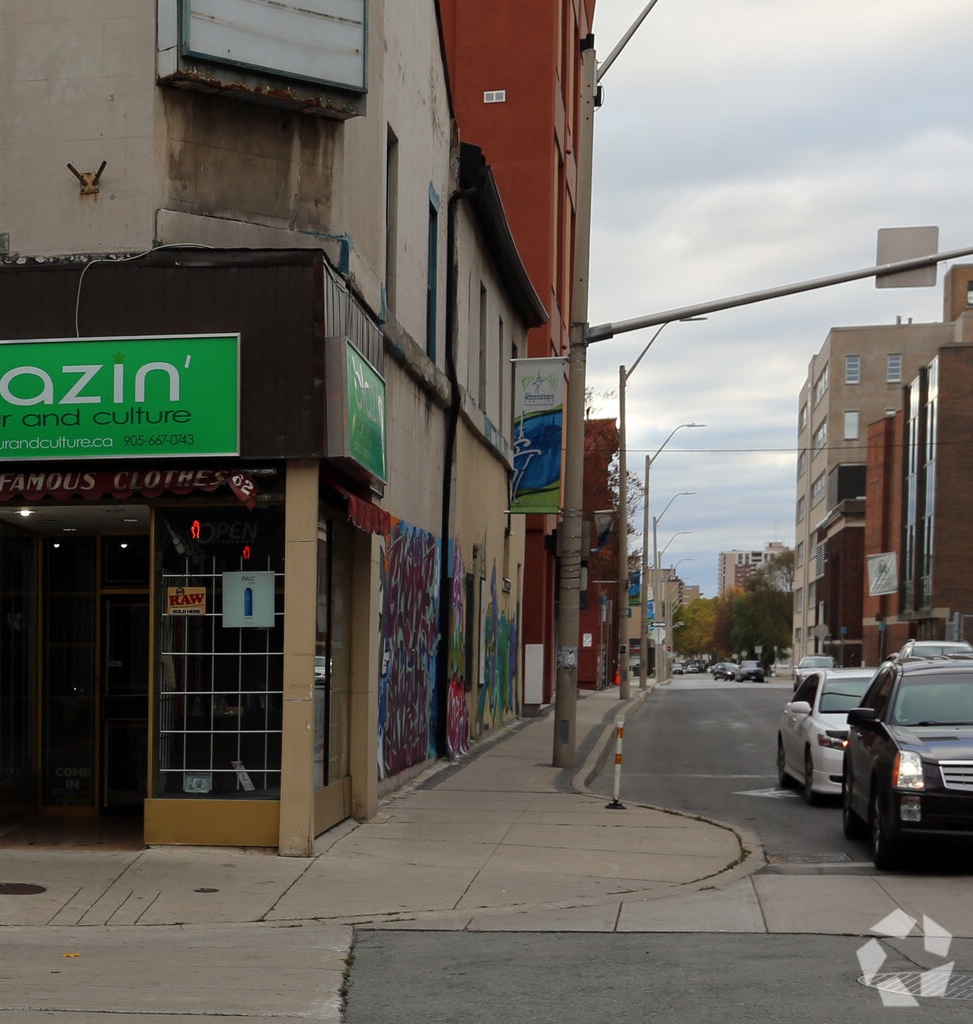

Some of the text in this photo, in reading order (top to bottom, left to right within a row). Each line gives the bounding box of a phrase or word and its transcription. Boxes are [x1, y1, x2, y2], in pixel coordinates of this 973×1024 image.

[21, 408, 81, 427] and
[92, 407, 192, 426] culture
[123, 433, 195, 447] 905-667-0743
[113, 469, 229, 490] CLOTHES
[232, 473, 254, 496] 62
[169, 593, 205, 606] RAW
[55, 767, 90, 777] COME
[66, 779, 80, 789] IN
